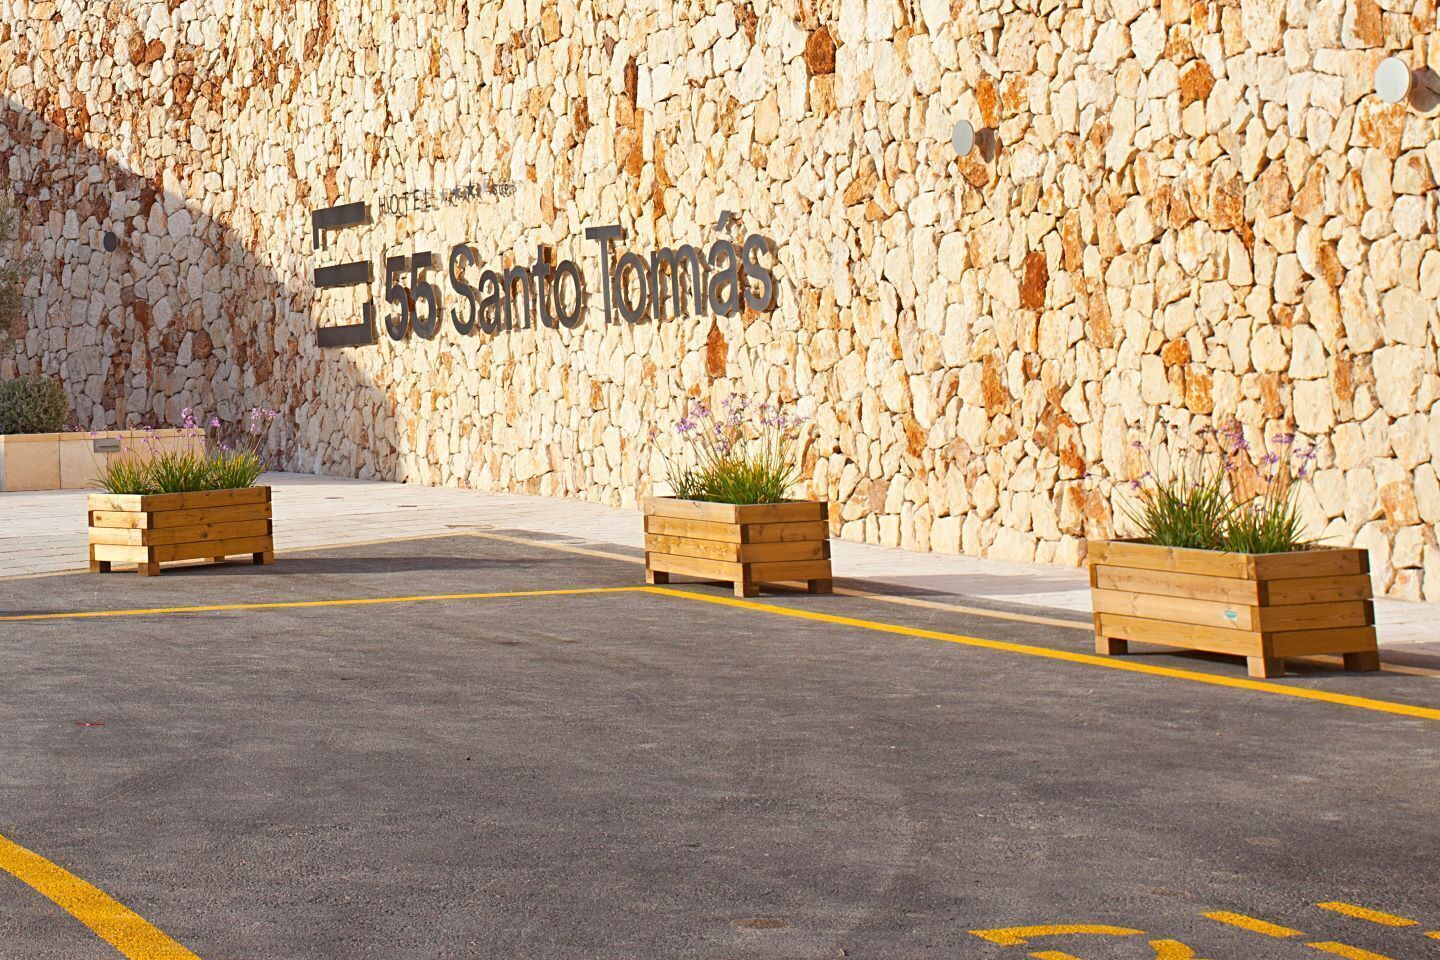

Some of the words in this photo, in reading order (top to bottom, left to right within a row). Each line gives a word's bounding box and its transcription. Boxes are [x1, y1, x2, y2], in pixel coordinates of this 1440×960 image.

[378, 187, 432, 216] HOTEL
[385, 251, 437, 341] 55
[449, 243, 581, 336] Santo
[585, 210, 772, 324] Tomás
